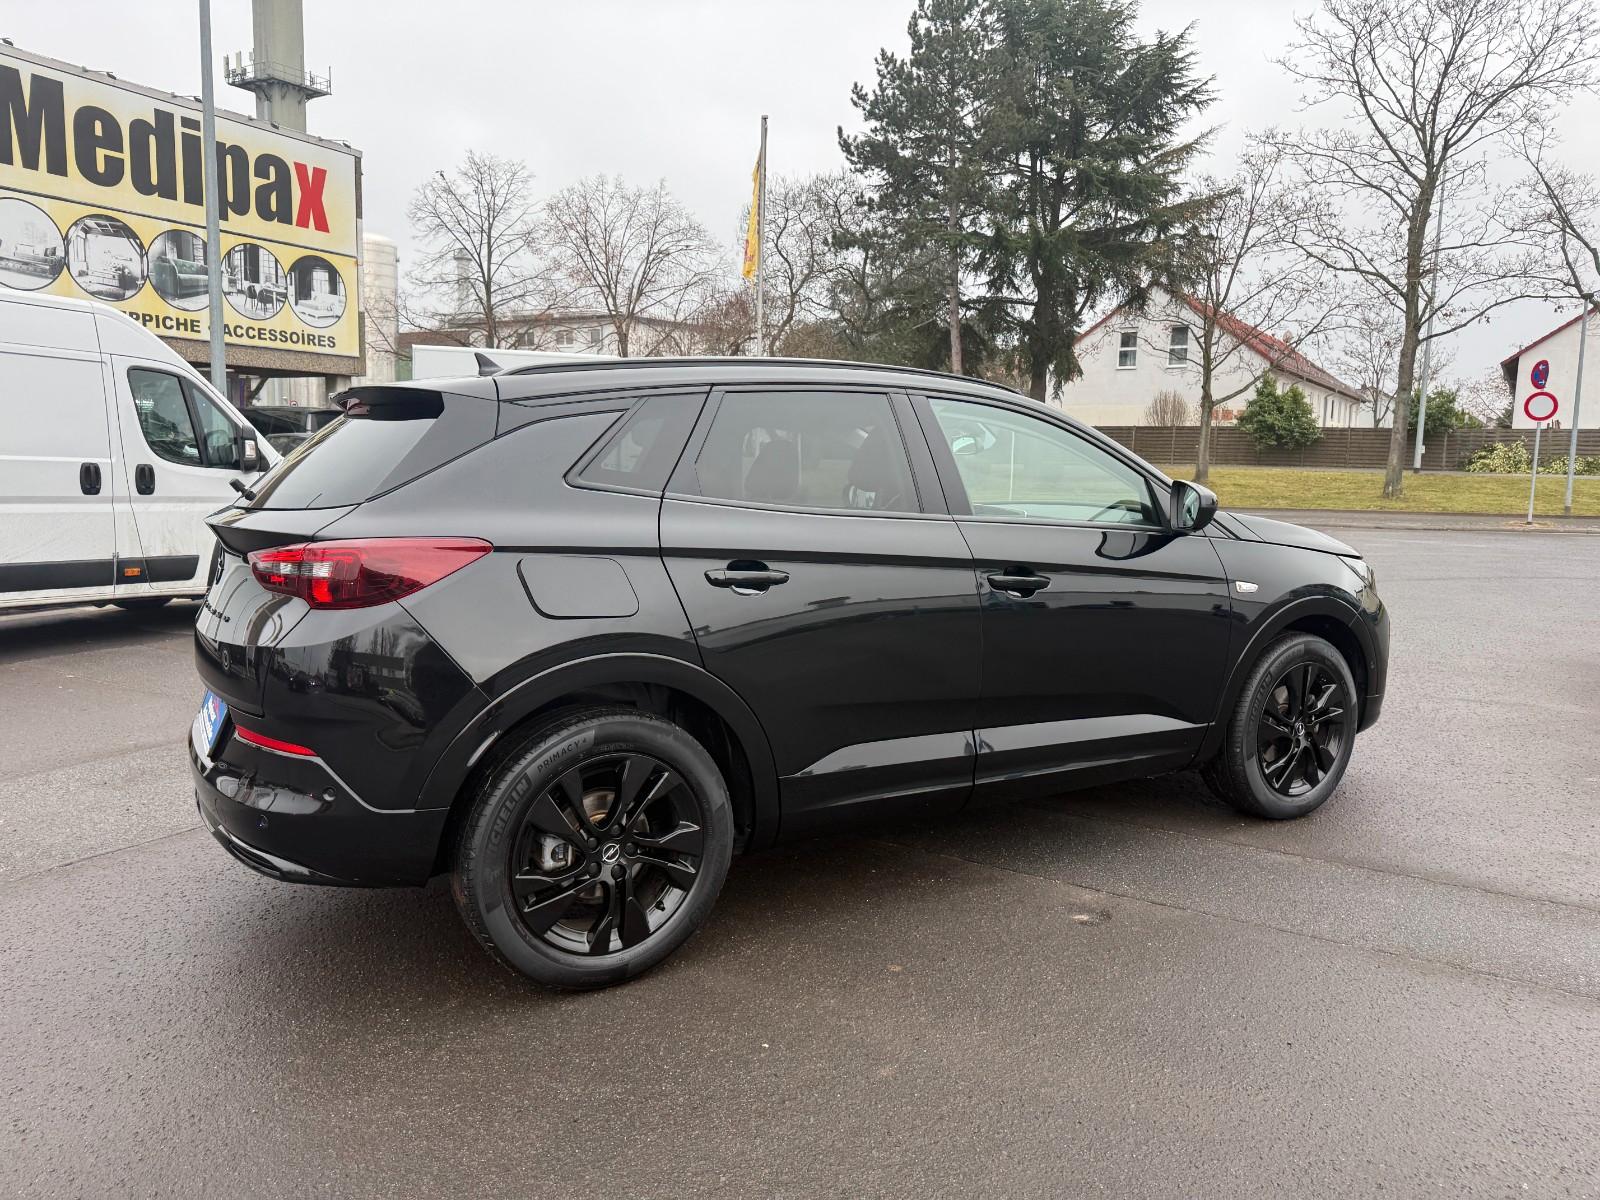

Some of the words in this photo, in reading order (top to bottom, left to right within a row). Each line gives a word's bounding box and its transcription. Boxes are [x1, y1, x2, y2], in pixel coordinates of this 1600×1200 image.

[0, 65, 330, 233] Medipax
[121, 310, 201, 334] PPICHE
[537, 739, 580, 773] PRIMACY
